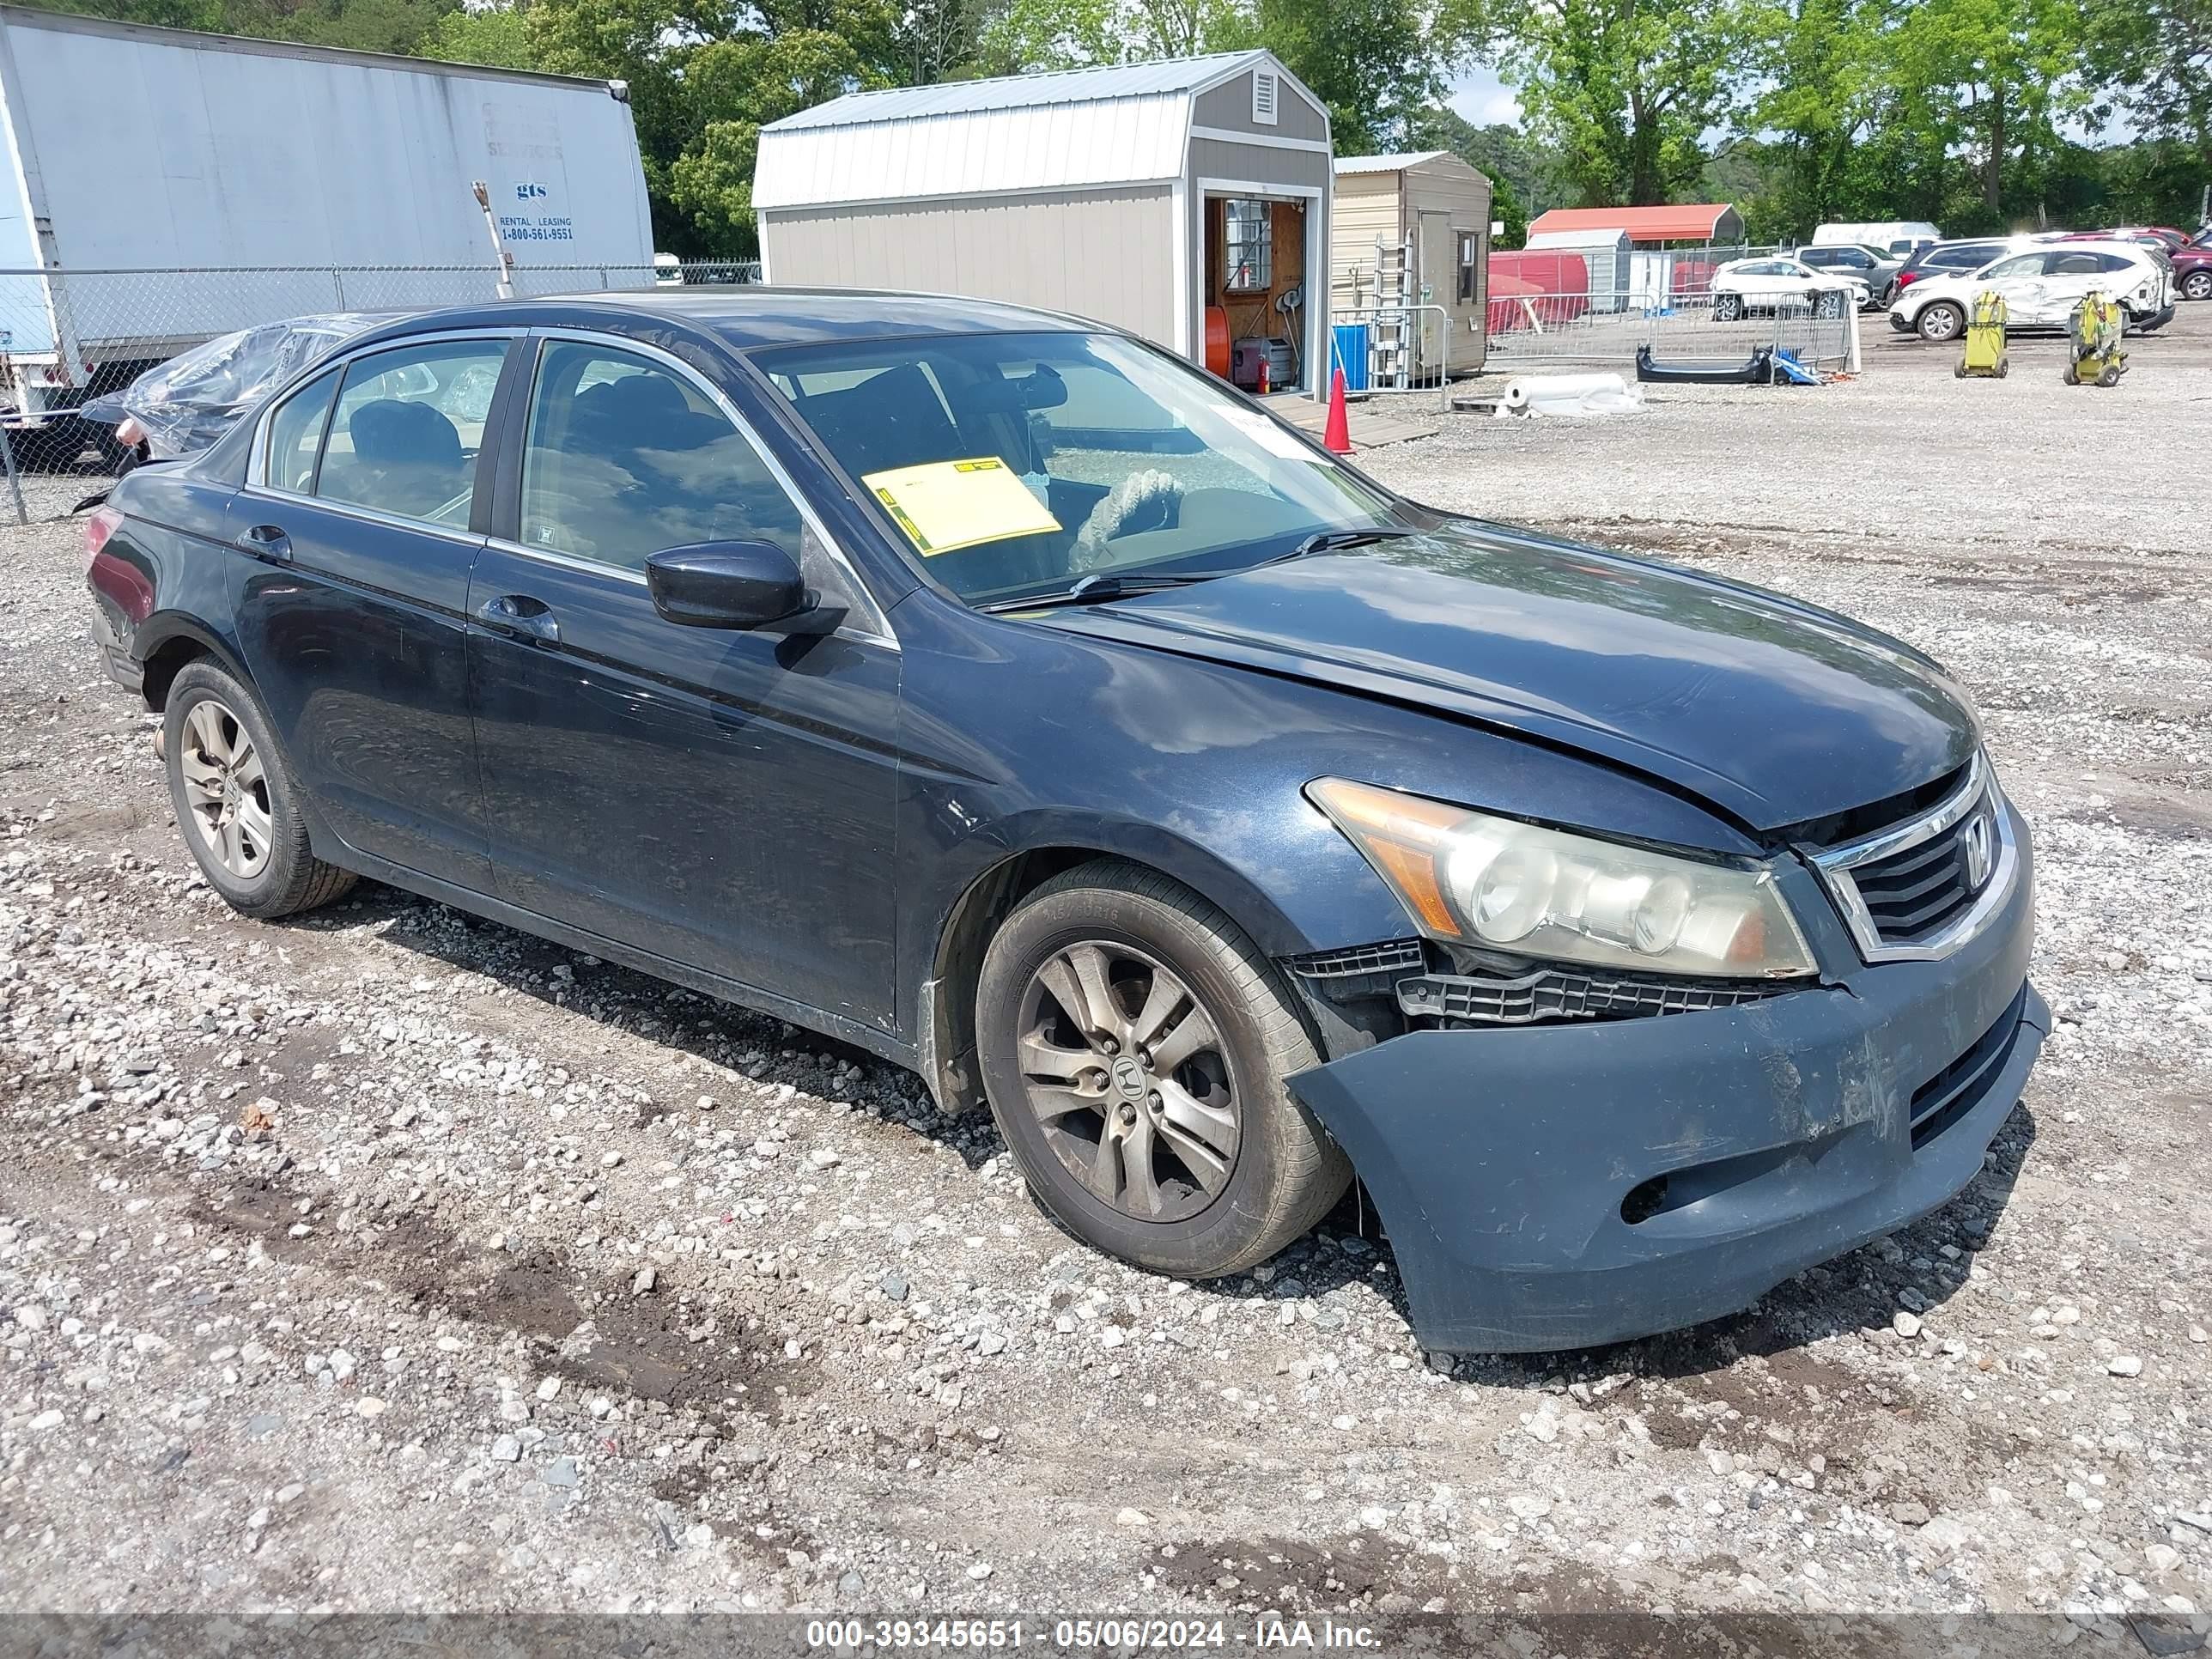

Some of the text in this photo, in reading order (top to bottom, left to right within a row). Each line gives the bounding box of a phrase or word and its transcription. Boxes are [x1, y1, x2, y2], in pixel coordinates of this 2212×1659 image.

[488, 142, 563, 159] SEICS
[516, 183, 547, 201] gts
[500, 217, 572, 227] RENTAL LEASING
[502, 228, 573, 240] 1-800-561-9551
